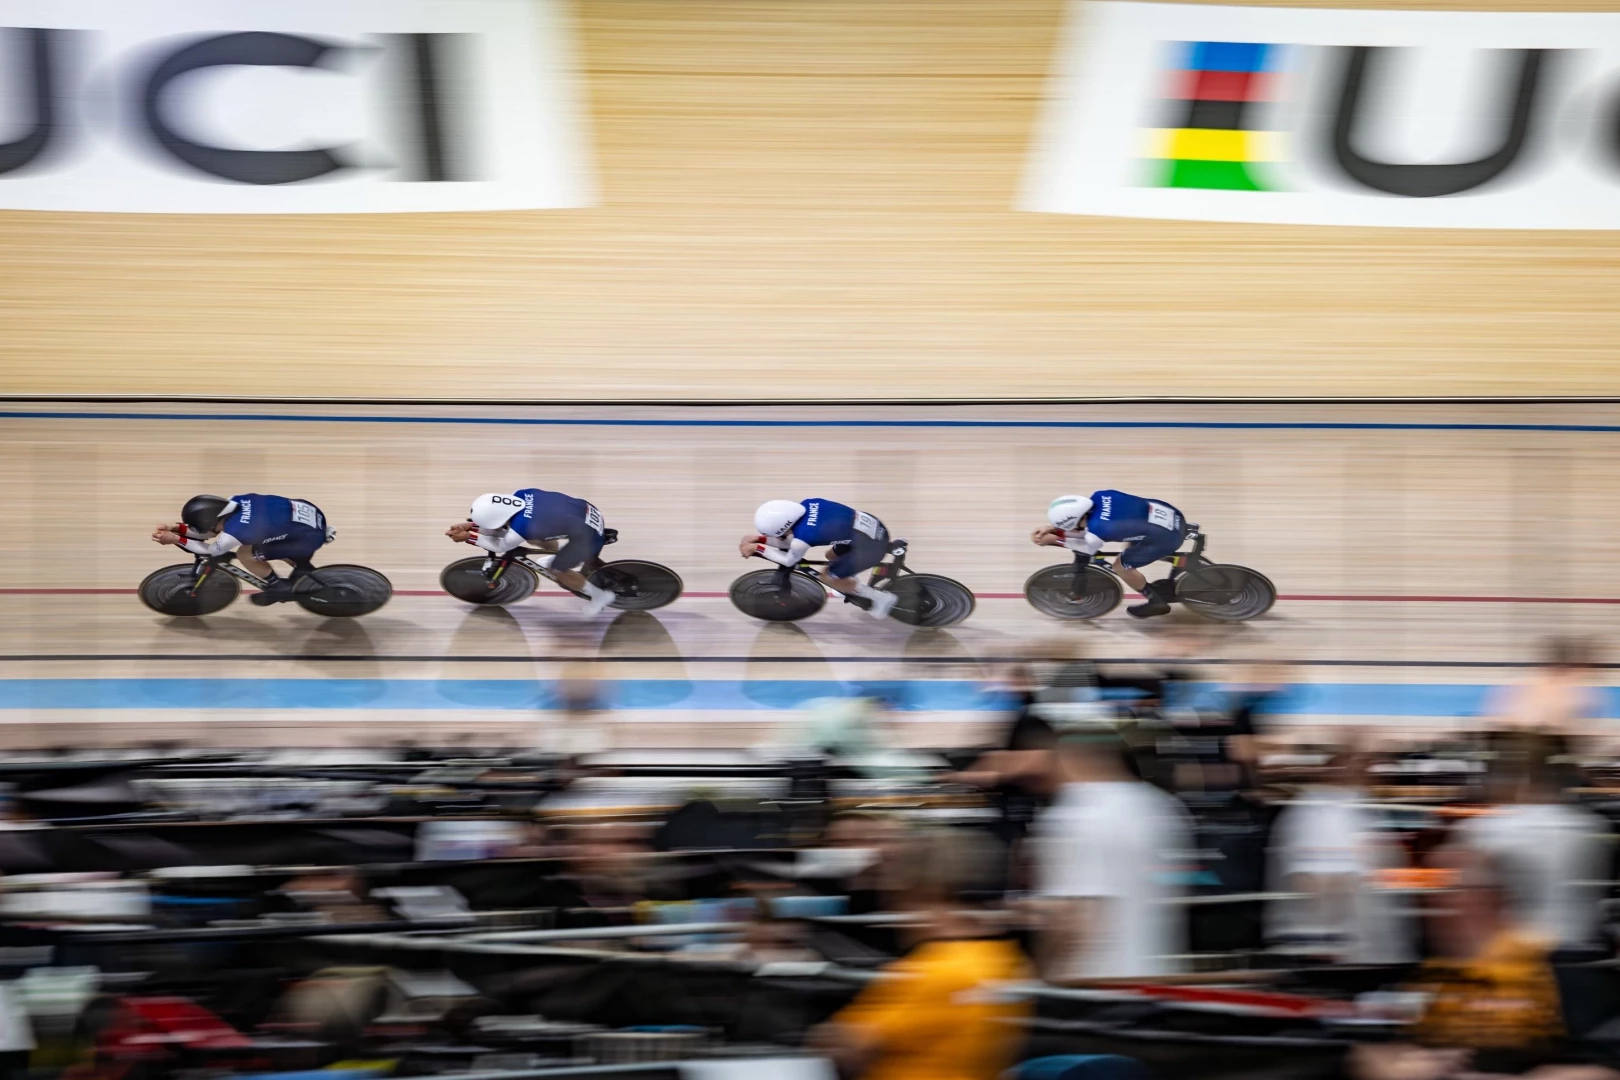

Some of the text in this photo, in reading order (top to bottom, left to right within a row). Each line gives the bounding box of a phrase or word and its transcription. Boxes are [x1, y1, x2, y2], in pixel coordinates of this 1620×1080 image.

[240, 499, 252, 523] FRANCE
[297, 503, 311, 522] 105
[492, 495, 523, 507] POC
[523, 493, 534, 518] FRANCE
[1100, 495, 1112, 521] FRANCE
[806, 502, 820, 526] FRANCE
